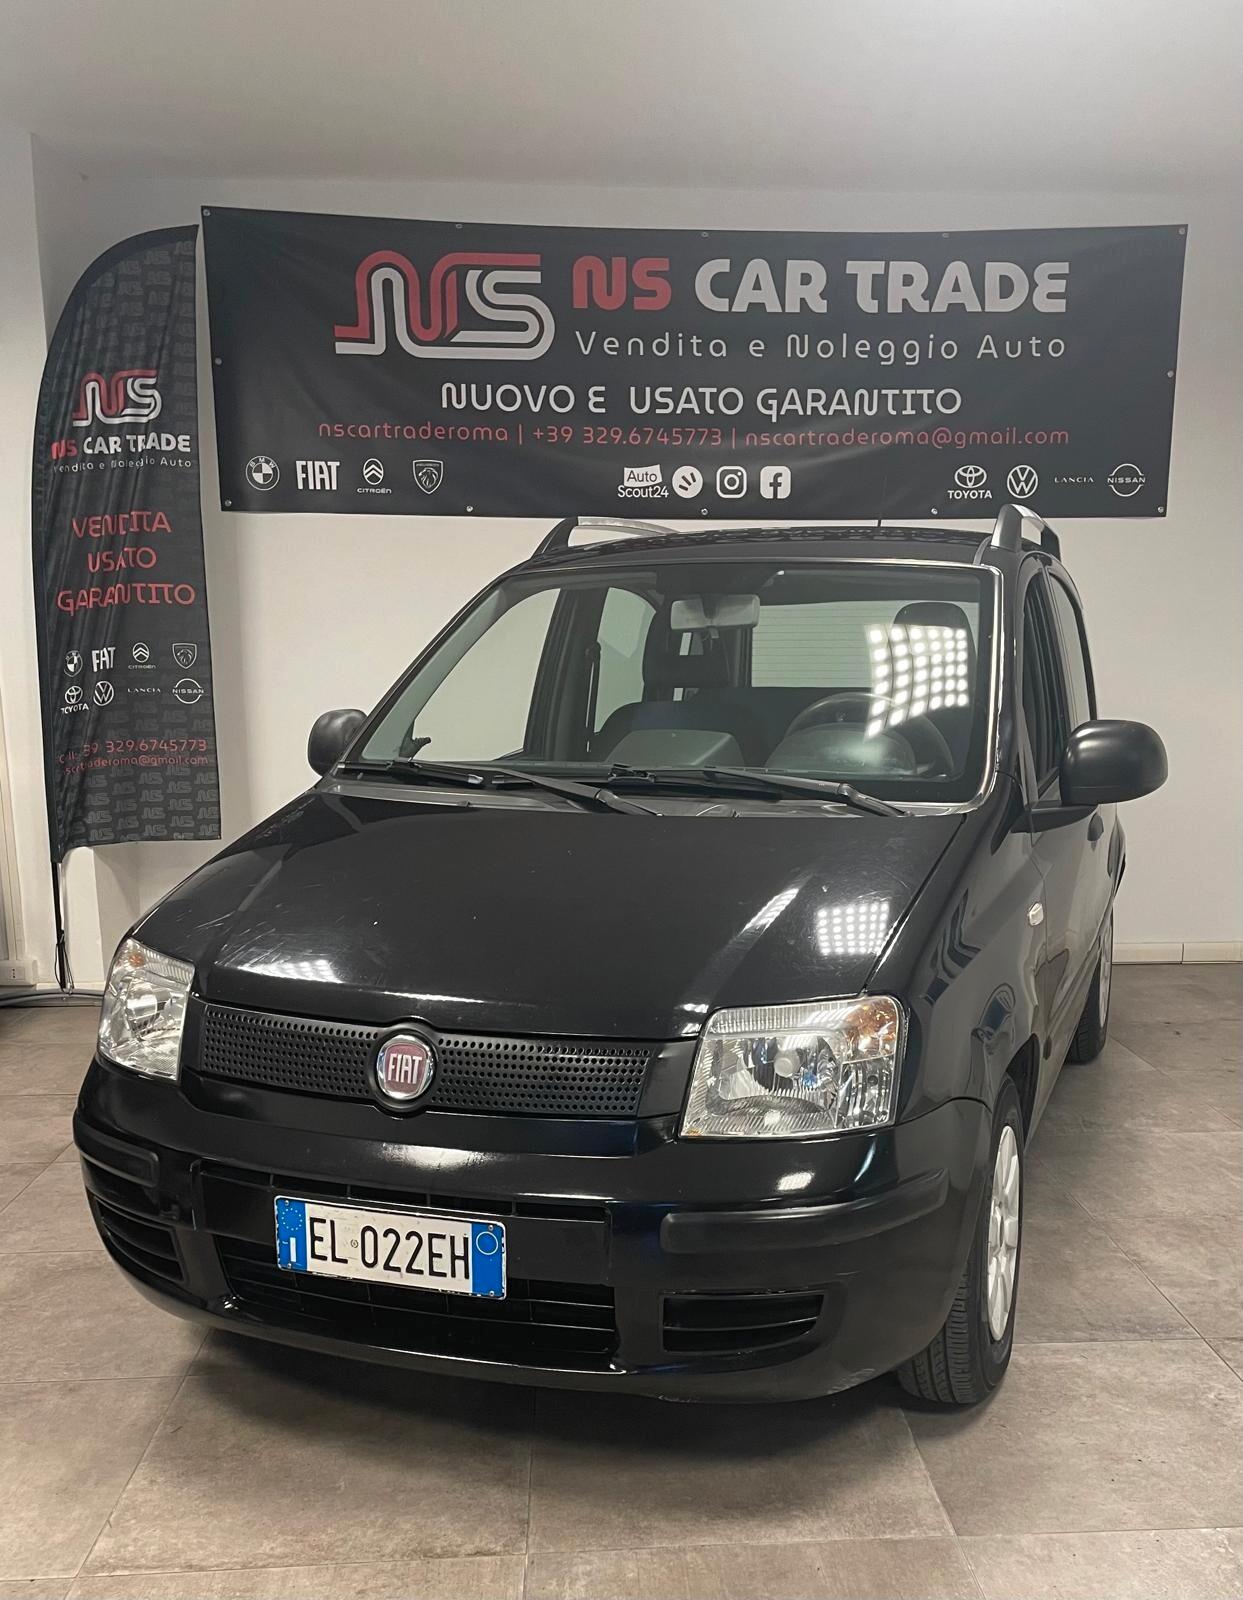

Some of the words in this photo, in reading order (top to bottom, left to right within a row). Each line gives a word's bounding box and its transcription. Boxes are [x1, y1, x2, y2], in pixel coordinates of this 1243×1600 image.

[572, 255, 672, 311] NS
[694, 258, 828, 313] CAR
[846, 260, 1070, 313] TRADE
[575, 330, 728, 358] Vendita
[749, 339, 765, 358] e
[786, 333, 958, 365] Noleggio
[977, 335, 1066, 359] Auto
[441, 382, 575, 414] NUOVO
[587, 386, 607, 414] E
[629, 386, 744, 415] USATO
[756, 387, 962, 423] GARANTITO
[83, 436, 121, 454] CAR
[318, 421, 509, 442] nscartraderoma
[533, 426, 573, 444] +39
[583, 426, 722, 446] 329.6745773
[745, 427, 1070, 450] nscartraderoma@gmail.com
[160, 457, 192, 468] Auto
[295, 460, 341, 491] FIAT
[626, 470, 658, 483] Auto
[1107, 476, 1146, 484] NISSAN
[617, 485, 669, 498] Scout24
[947, 489, 993, 500] TOYOTA
[87, 547, 157, 573] USATO
[57, 583, 196, 616] GARANTITO
[105, 739, 208, 753] 329.6745773
[388, 1053, 423, 1085] FIAT
[309, 1217, 349, 1264] EL
[361, 1225, 470, 1280] 022EH
